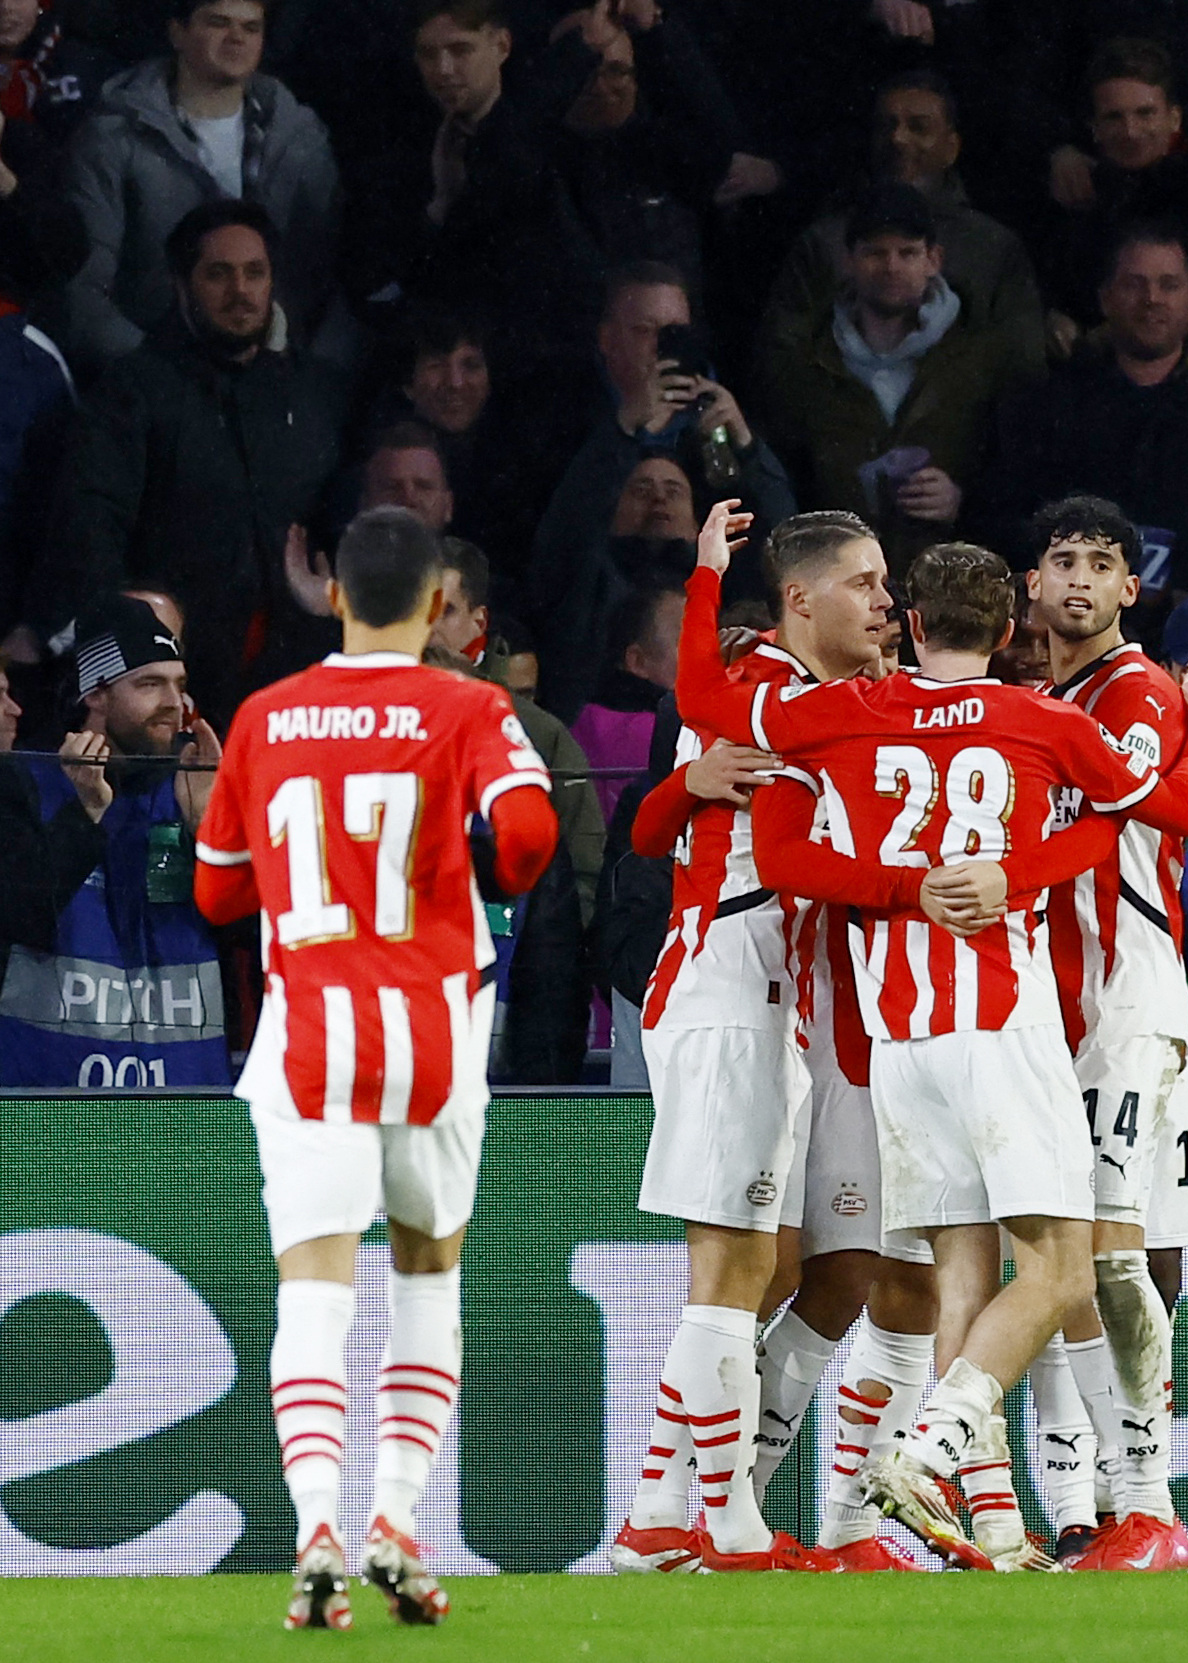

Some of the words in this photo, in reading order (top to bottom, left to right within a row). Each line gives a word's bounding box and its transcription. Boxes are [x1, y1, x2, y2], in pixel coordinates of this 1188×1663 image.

[266, 705, 377, 745] MAURO
[378, 704, 429, 742] JR.
[912, 697, 985, 729] LAND
[1127, 734, 1157, 761] TOTO
[874, 744, 1017, 870] 28
[266, 771, 426, 952] 17
[1081, 1088, 1140, 1148] 14
[1046, 1460, 1081, 1471] PSV
[1126, 1444, 1159, 1457] PSV
